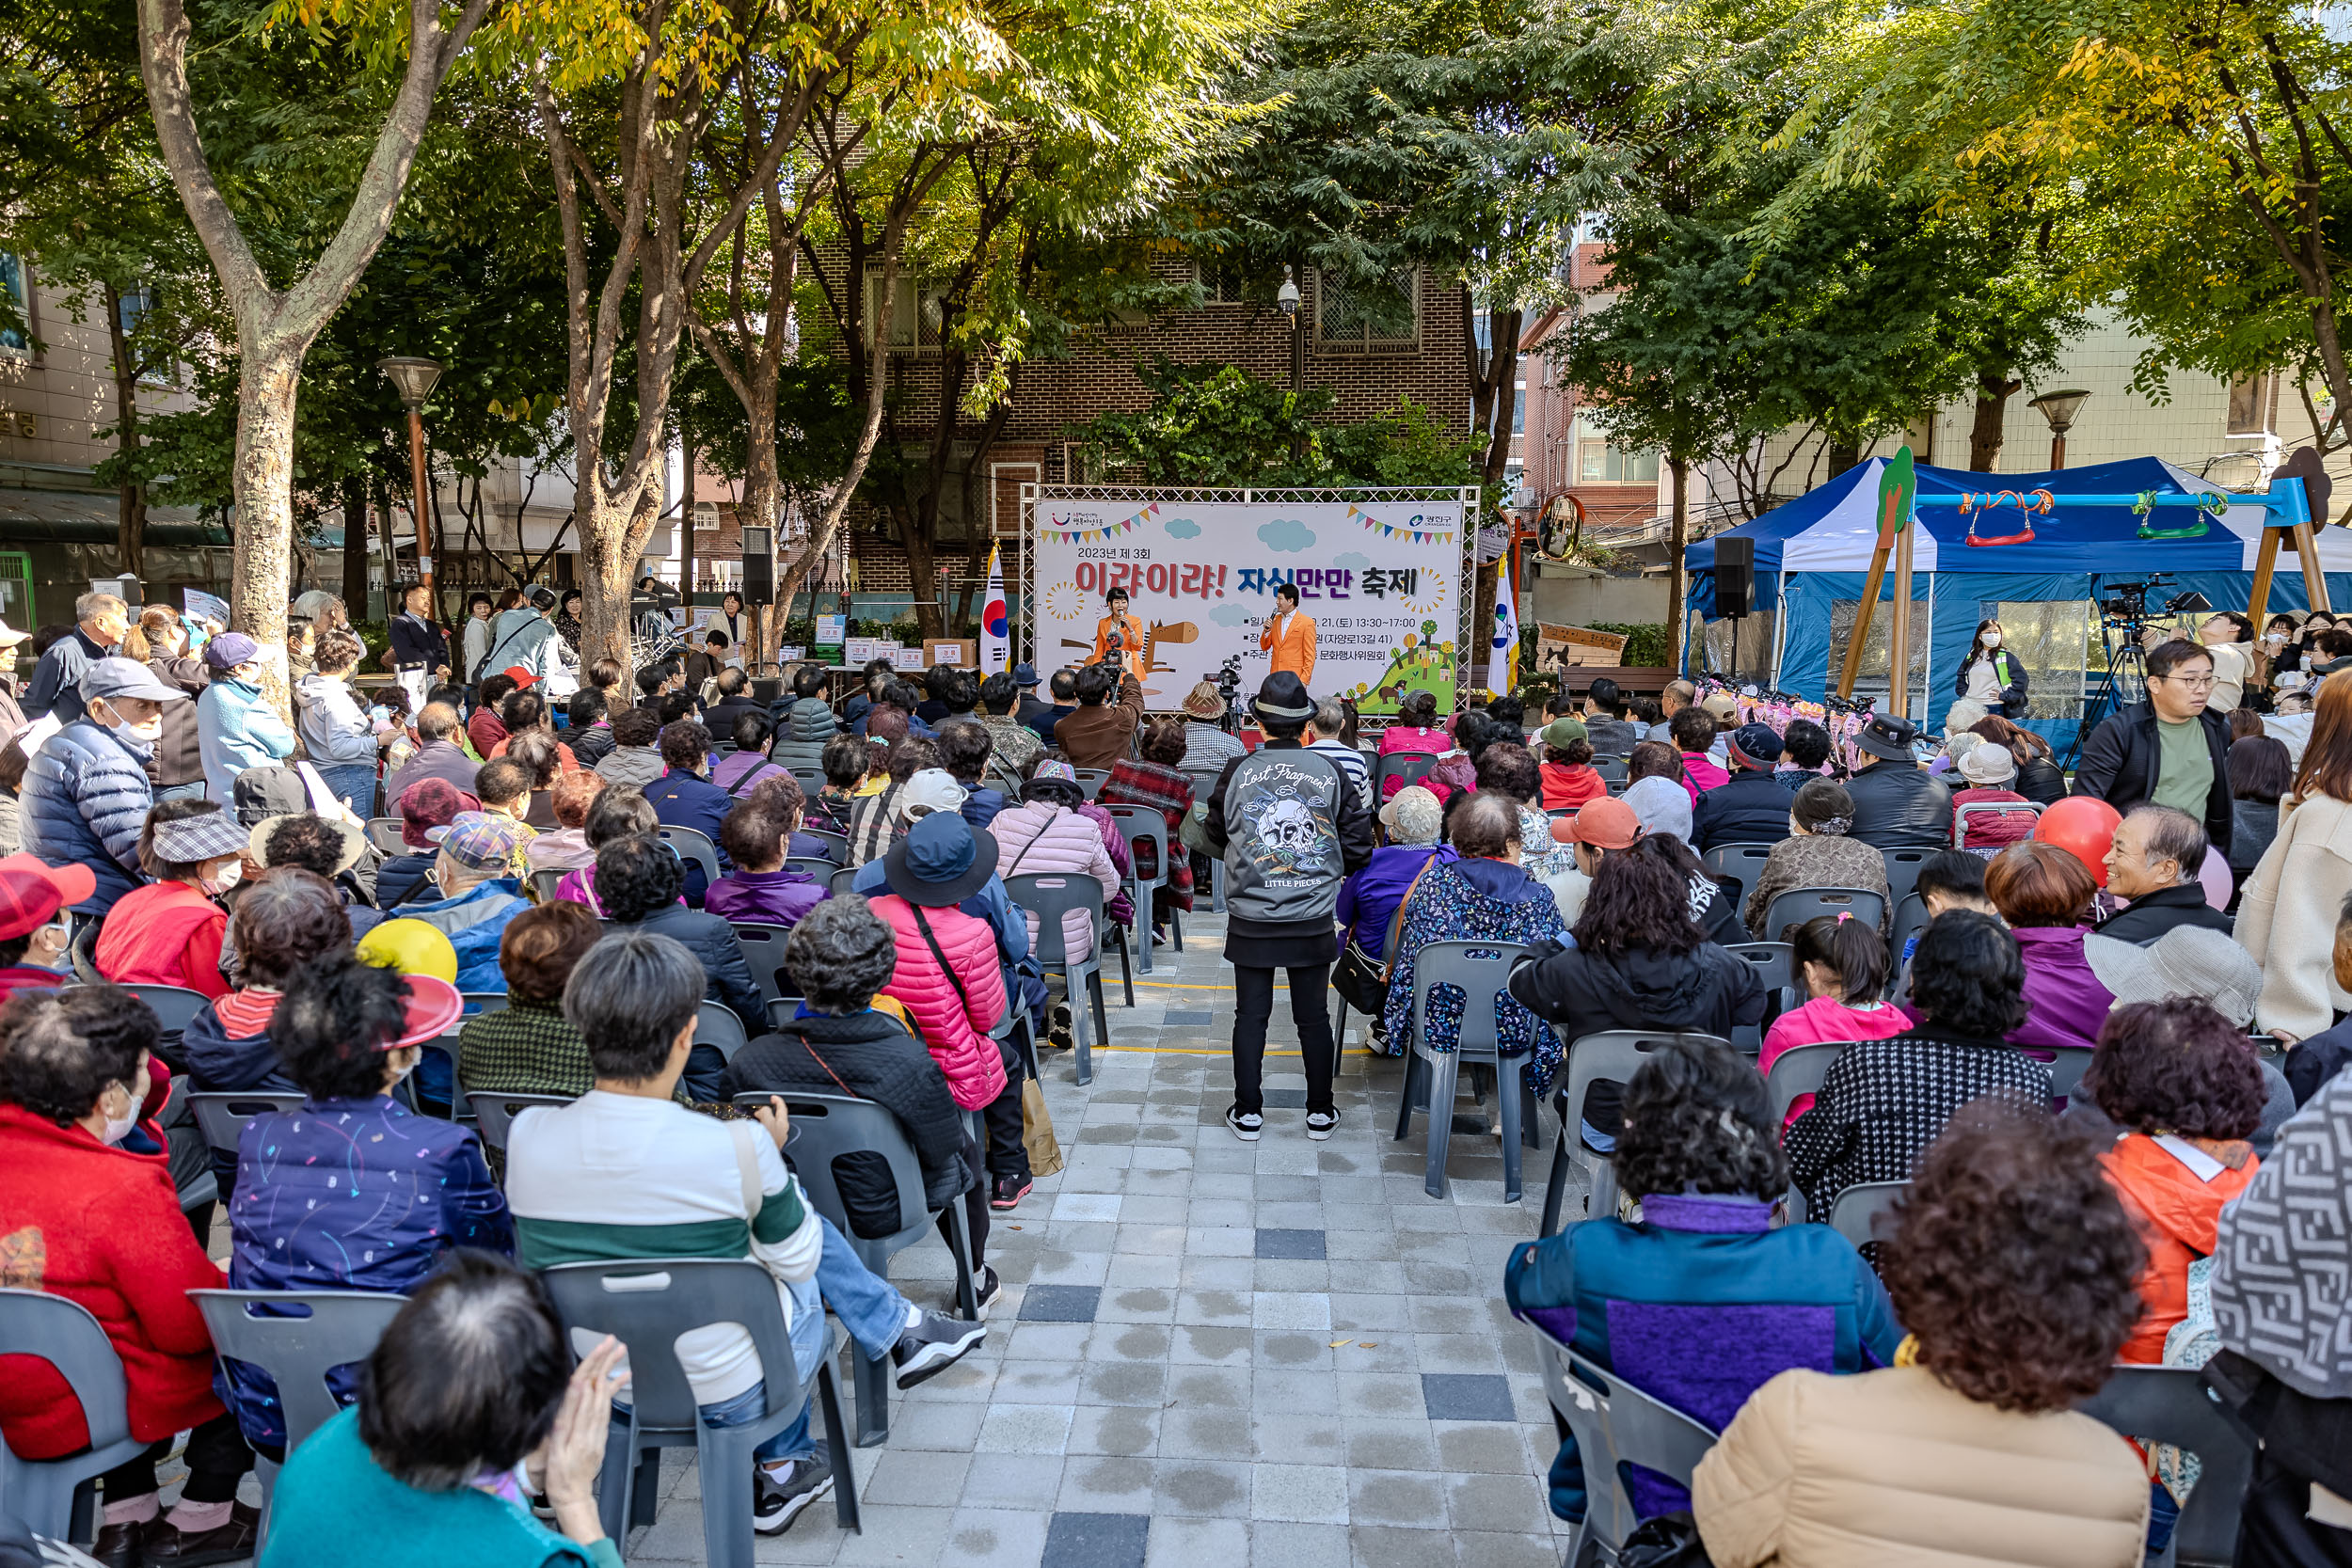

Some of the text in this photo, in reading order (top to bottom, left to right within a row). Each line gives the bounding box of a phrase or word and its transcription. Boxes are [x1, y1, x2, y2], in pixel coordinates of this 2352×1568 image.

[1078, 548, 1151, 560] 2023년 제 3회
[1075, 562, 1228, 599] 이랴이랴!
[1237, 567, 1418, 599] 자신만만 축제
[1356, 618, 1416, 627] 13:30~17:00
[1377, 634, 1393, 644] 41)
[1249, 649, 1386, 661] 주관 문화행사위원회
[1239, 763, 1335, 793] Lost Fragment
[1264, 878, 1322, 888] LITTLE PIECES
